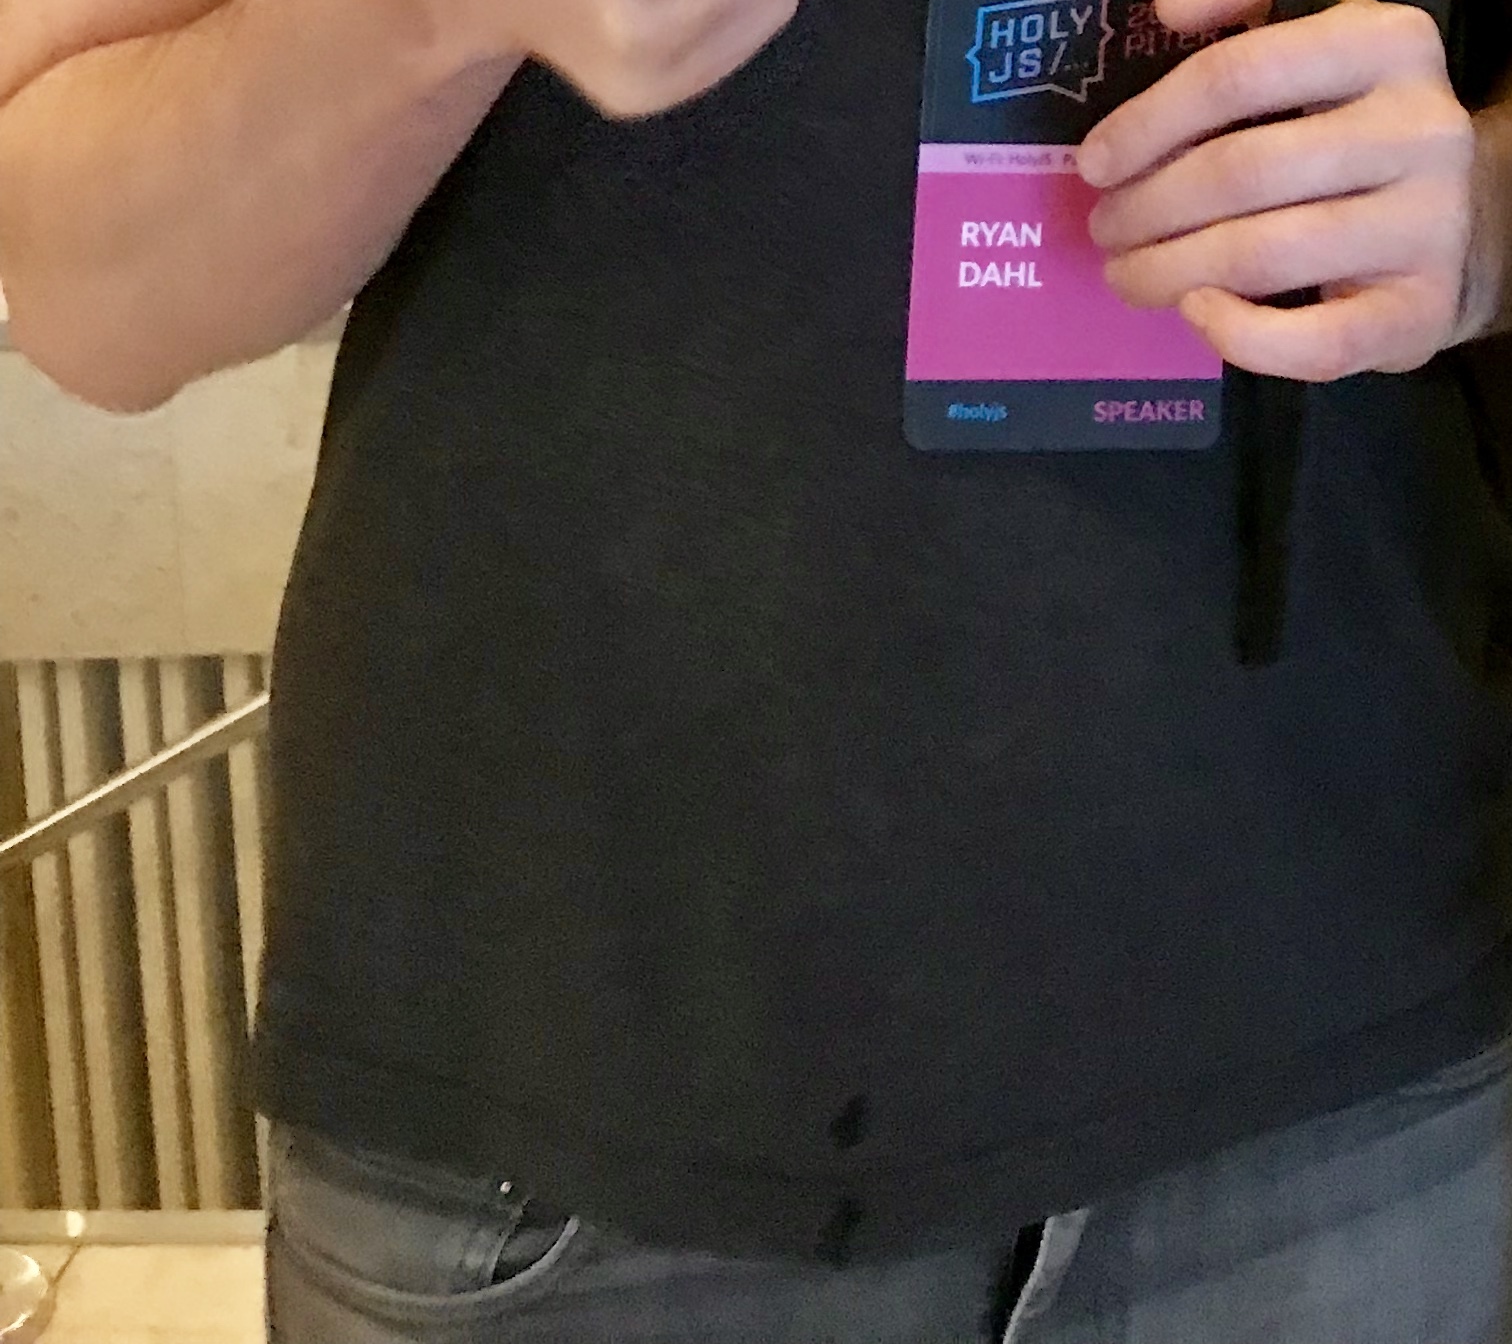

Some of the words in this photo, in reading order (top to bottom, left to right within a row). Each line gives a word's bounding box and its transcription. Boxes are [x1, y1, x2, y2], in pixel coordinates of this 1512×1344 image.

[989, 4, 1094, 49] HOLY
[961, 221, 1043, 249] RYAN
[957, 261, 1043, 288] DAHL
[1094, 399, 1205, 423] SPEAKER
